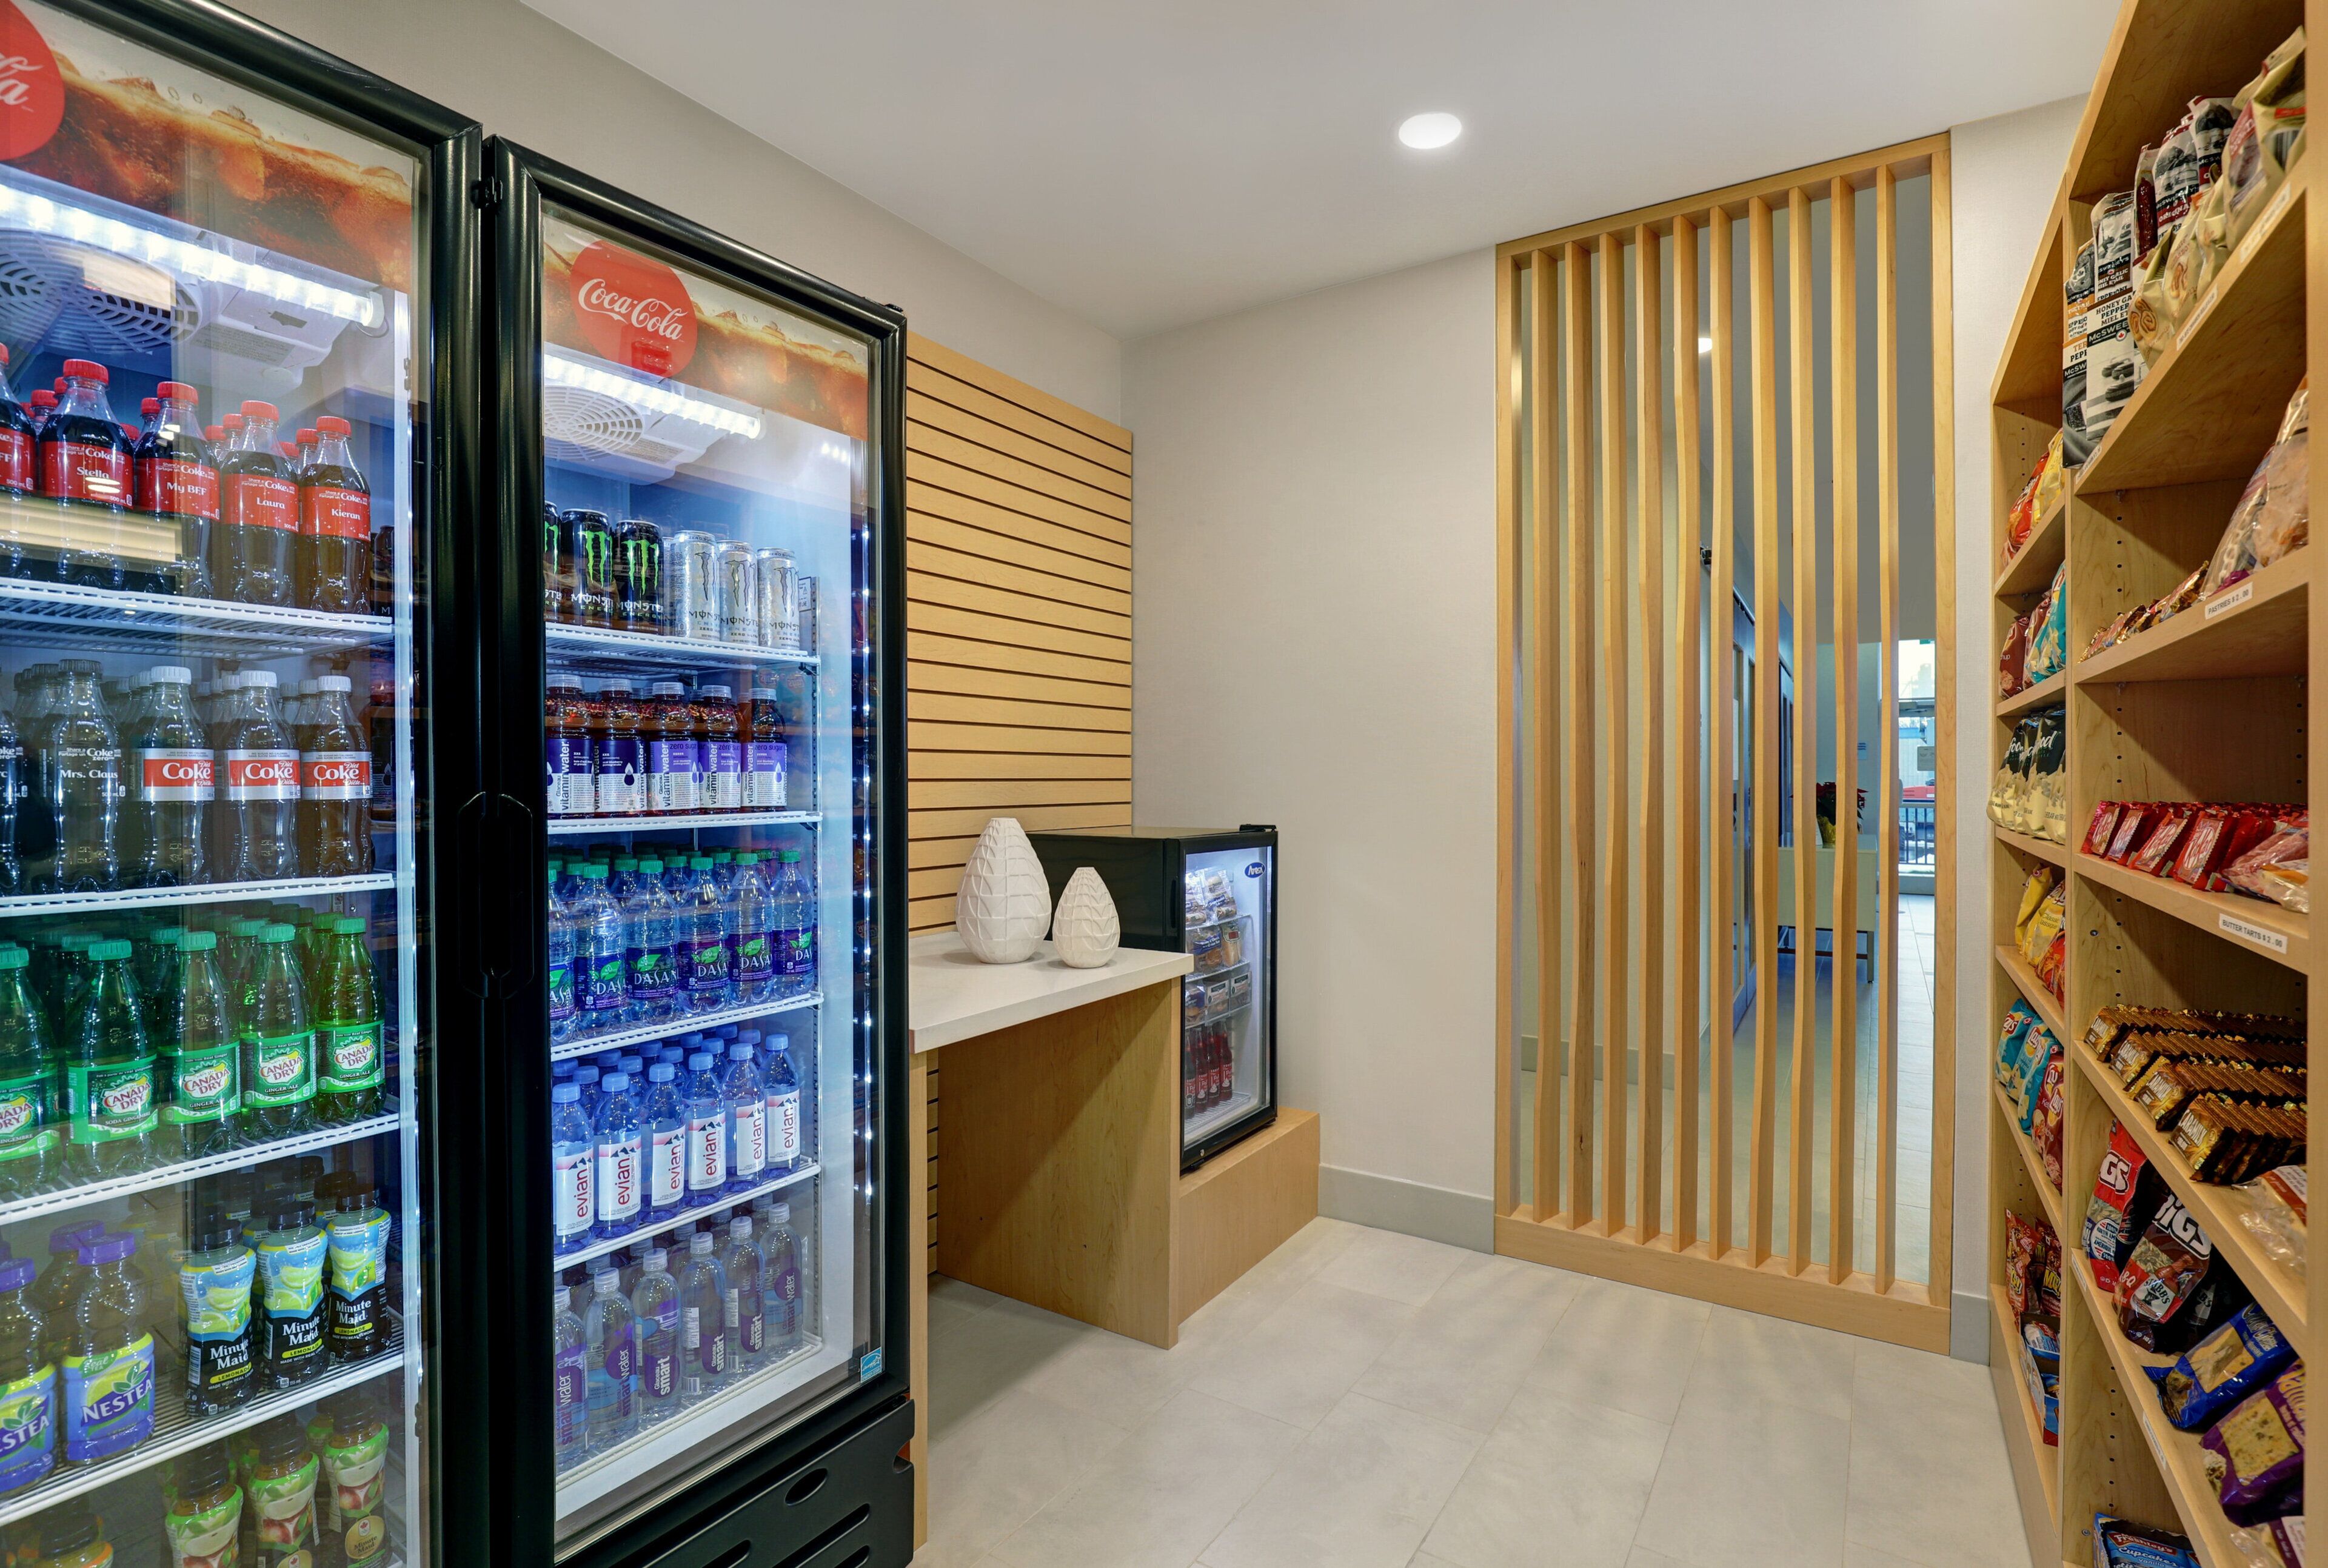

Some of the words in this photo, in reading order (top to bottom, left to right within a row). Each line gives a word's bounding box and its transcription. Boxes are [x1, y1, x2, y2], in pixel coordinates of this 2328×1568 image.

[578, 278, 688, 340] Coca-Cola
[2096, 300, 2121, 315] HONEY
[2101, 316, 2119, 326] MIEL
[85, 448, 113, 461] Coke
[76, 466, 109, 479] Stella
[181, 465, 205, 477] Coke
[167, 482, 185, 493] My
[187, 485, 207, 496] BFF
[264, 480, 287, 492] Coke
[256, 497, 286, 509] Laura
[341, 492, 361, 504] Coke
[331, 509, 361, 520] Kieran
[2209, 599, 2230, 615] PASTRIES
[87, 747, 113, 757] Coke
[60, 769, 86, 779] Mrs.
[89, 769, 118, 779] Claus
[162, 762, 211, 779] Coke
[245, 763, 293, 779] Coke
[313, 764, 360, 780] Coke
[560, 741, 570, 811] vitaminwater
[661, 742, 671, 807] vitaminwater
[708, 743, 718, 806] vitaminwater
[2222, 919, 2242, 932] BUTTER
[2243, 927, 2261, 939] TARTS
[335, 1043, 375, 1064] CANADA
[347, 1053, 369, 1067] DRY
[259, 1056, 303, 1077] CANADA
[273, 1066, 296, 1081] DRY
[183, 1068, 231, 1092] CANADA
[198, 1079, 223, 1095] DRY
[102, 1082, 152, 1108] CANADA
[121, 1093, 144, 1111] DRY
[189, 1099, 214, 1109] GINGER
[781, 1107, 794, 1149] evian
[751, 1116, 762, 1160] evian
[703, 1130, 717, 1176] evian
[668, 1143, 681, 1190] evian
[615, 1158, 630, 1205] evian
[574, 1167, 589, 1218] evian
[335, 1299, 372, 1314] Minute
[283, 1315, 320, 1337] Minute
[339, 1311, 367, 1325] Maid
[289, 1326, 318, 1347] Maid
[338, 1326, 366, 1335] LEMONADE
[210, 1338, 249, 1361] Minute
[280, 1356, 293, 1365] MADE
[293, 1353, 304, 1362] WITH
[304, 1350, 315, 1359] REAL
[290, 1342, 319, 1357] LEMONADE
[216, 1348, 249, 1371] Maid
[218, 1364, 250, 1381] LEMONADE
[658, 1355, 671, 1396] smart
[208, 1383, 221, 1391] MADE
[234, 1375, 245, 1384] REAL
[81, 1378, 153, 1424] NESTEA
[354, 1535, 378, 1551] Minute
[2114, 1533, 2173, 1554] Freshley's
[2118, 1547, 2179, 1567] Cupcakes
[2138, 1557, 2166, 1568] vanilla
